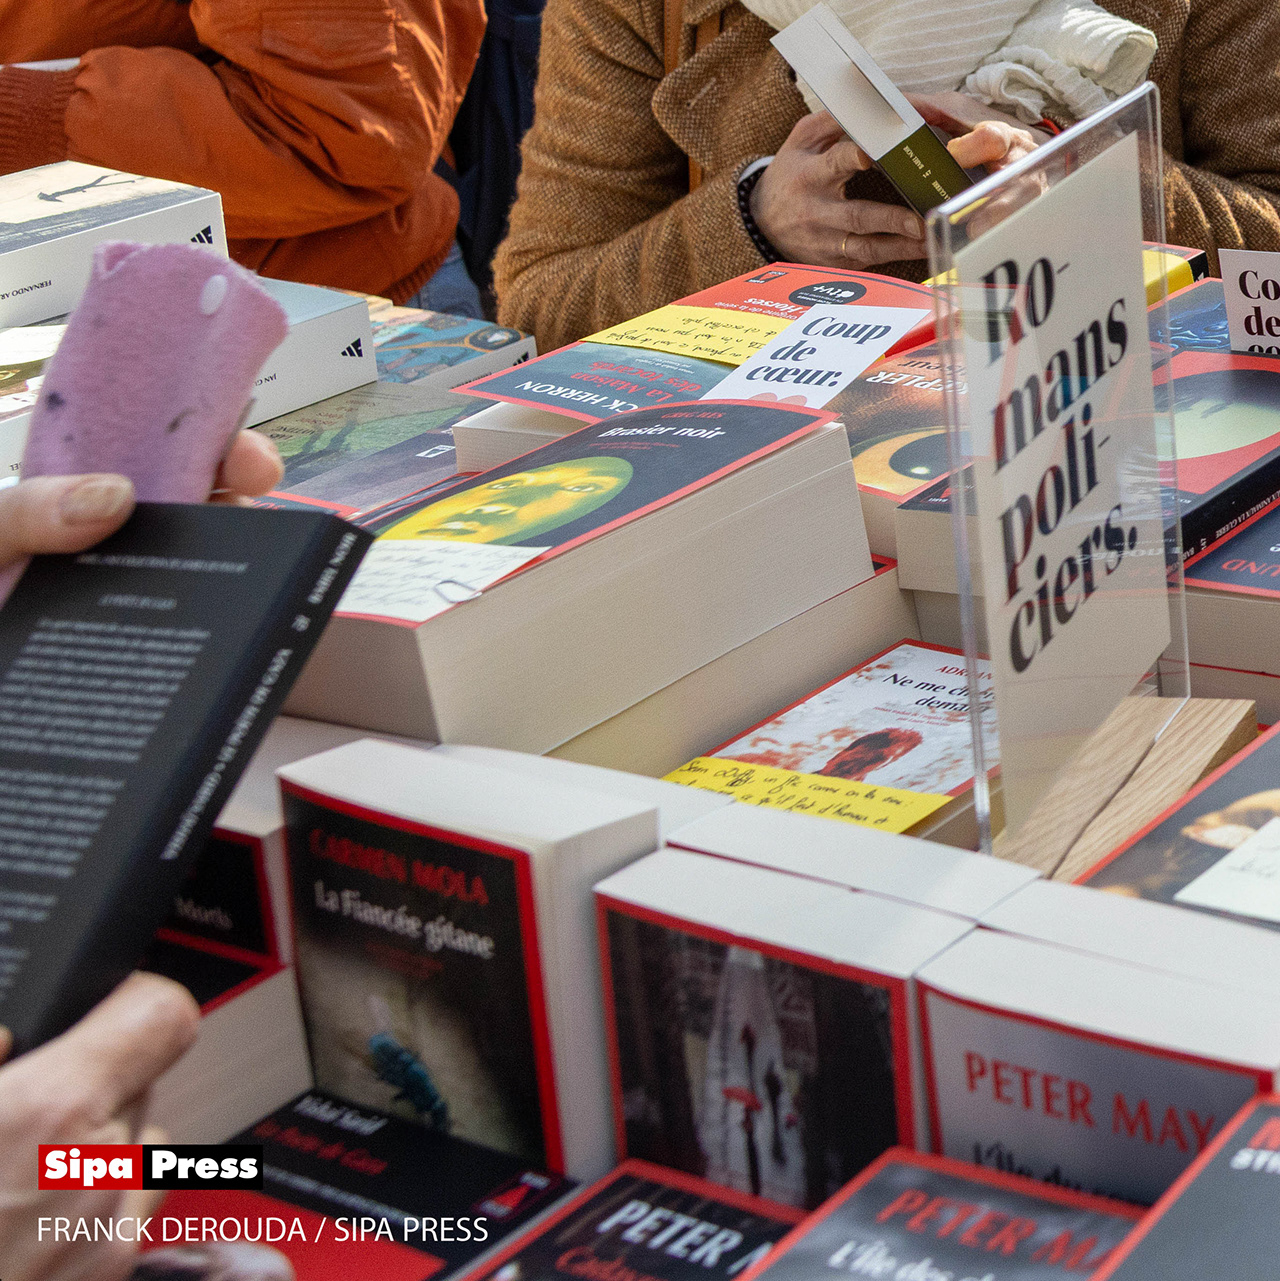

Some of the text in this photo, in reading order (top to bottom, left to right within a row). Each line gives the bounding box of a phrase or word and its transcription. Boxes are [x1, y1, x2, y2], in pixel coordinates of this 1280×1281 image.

[10, 279, 53, 299] FERNANDO
[978, 250, 1071, 370] Ro-
[801, 315, 893, 348] Coup
[769, 337, 816, 362] de
[263, 372, 279, 383] JAN
[570, 371, 674, 403] La Maison
[588, 361, 659, 387] tocards
[664, 377, 703, 394] des
[745, 360, 843, 389] cœur.
[989, 297, 1130, 476] mans
[514, 379, 603, 405] HERRON
[597, 424, 727, 439] Brasier noir
[996, 400, 1111, 607] poli-
[1006, 503, 1140, 676] ciers.
[883, 673, 947, 693] Ne me
[411, 858, 490, 907] MOLA
[314, 879, 496, 960] La Fiancée gitane
[965, 1051, 1220, 1155] PETER MAY
[597, 1198, 743, 1264] PETER
[877, 1188, 1037, 1258] PETER
